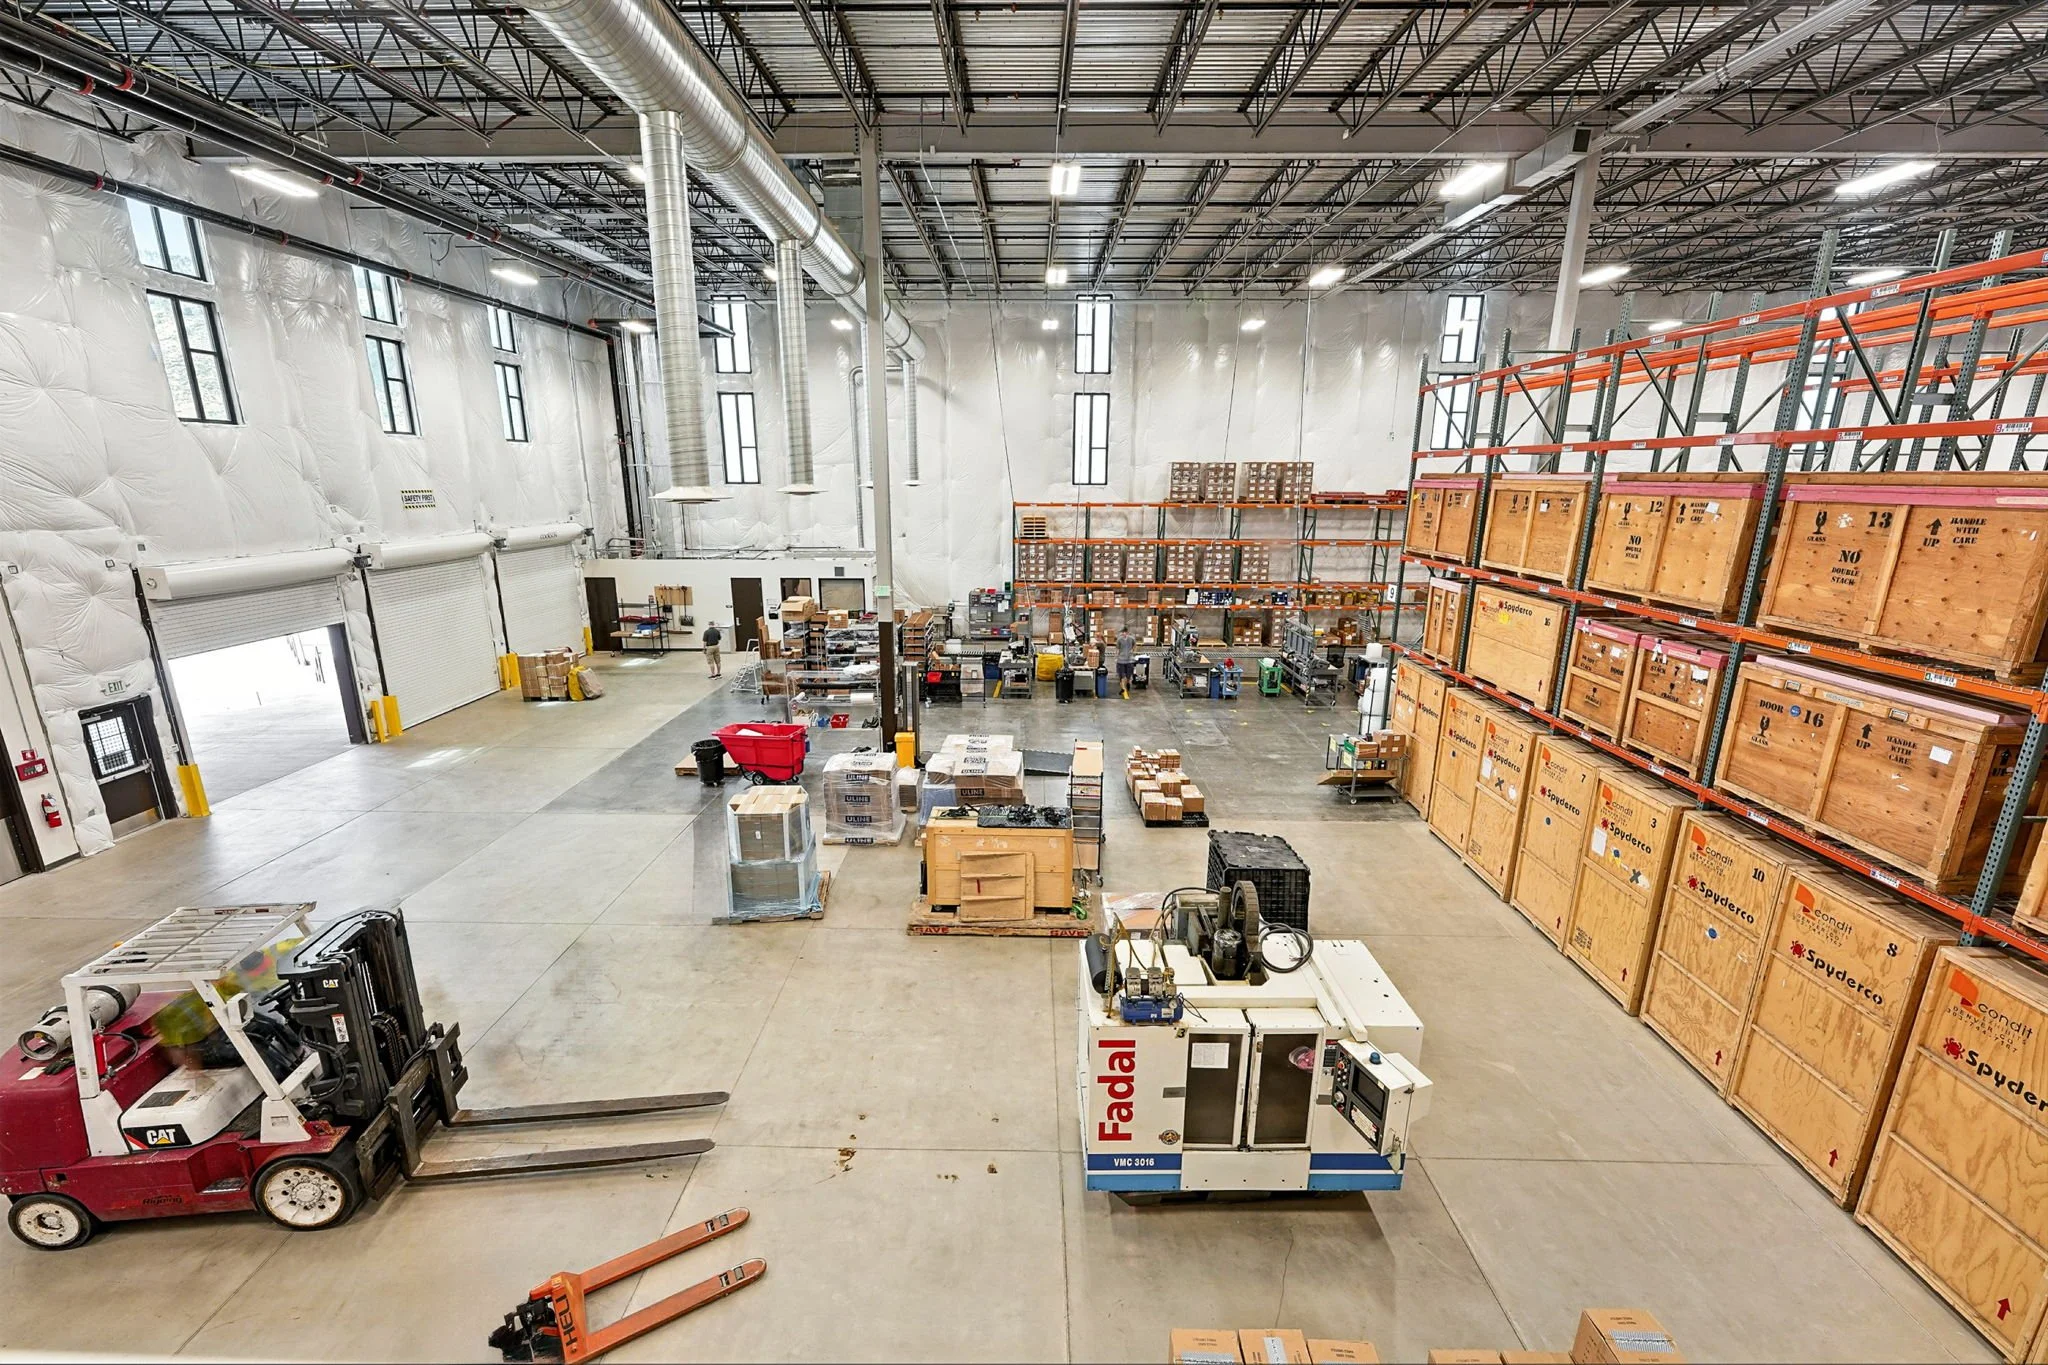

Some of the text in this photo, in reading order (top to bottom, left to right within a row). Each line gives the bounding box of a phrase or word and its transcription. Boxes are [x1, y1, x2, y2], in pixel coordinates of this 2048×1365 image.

[403, 493, 433, 502] SAFETY FIRST
[1648, 500, 1663, 513] 12
[1868, 511, 1893, 529] 13
[1951, 517, 1988, 526] HANDLE
[1956, 527, 1980, 535] WITH
[1628, 534, 1642, 546] NO
[1922, 538, 1940, 548] UP
[1952, 537, 1977, 545] CARE
[1838, 549, 1862, 565] NO
[1831, 566, 1860, 578] DOUBLE
[1830, 576, 1856, 586] STACK
[1390, 587, 1395, 599] 9
[1503, 601, 1533, 617] Spyderco
[1649, 664, 1666, 675] STACK
[1674, 665, 1680, 677] 7
[107, 680, 125, 693] EXIT
[1759, 699, 1784, 714] DOOR
[1803, 709, 1825, 728] 16
[1453, 730, 1477, 750] Spyderco
[1751, 735, 1769, 747] GLASS
[1855, 739, 1871, 750] UP
[1886, 735, 1918, 750] HANDLE
[1519, 743, 1524, 753] 2
[1890, 745, 1912, 756] WITH
[1493, 750, 1521, 774] Spyderco
[1888, 754, 1911, 766] CARE
[1581, 773, 1587, 783] 7
[962, 788, 984, 796] ULINE
[1546, 788, 1581, 816] Spyderco
[1611, 800, 1634, 817] condit
[1650, 818, 1657, 829] 3
[1609, 821, 1652, 855] Spyderco
[1705, 846, 1734, 867] condit
[1752, 867, 1765, 883] 10
[1698, 881, 1755, 925] Spyderco
[1814, 909, 1853, 935] condit
[913, 926, 950, 935] SAVE
[1050, 929, 1087, 937] SAVE
[1886, 942, 1898, 957] 8
[1806, 948, 1884, 1005] Spyderco
[322, 978, 339, 988] CAT
[1977, 1002, 2033, 1039] condit
[1177, 1028, 1186, 1038] 3
[1097, 1040, 1136, 1141] Fadal
[146, 1128, 176, 1145] CAT
[1113, 1158, 1155, 1167] VMC 3016
[555, 1293, 578, 1347] HELI
